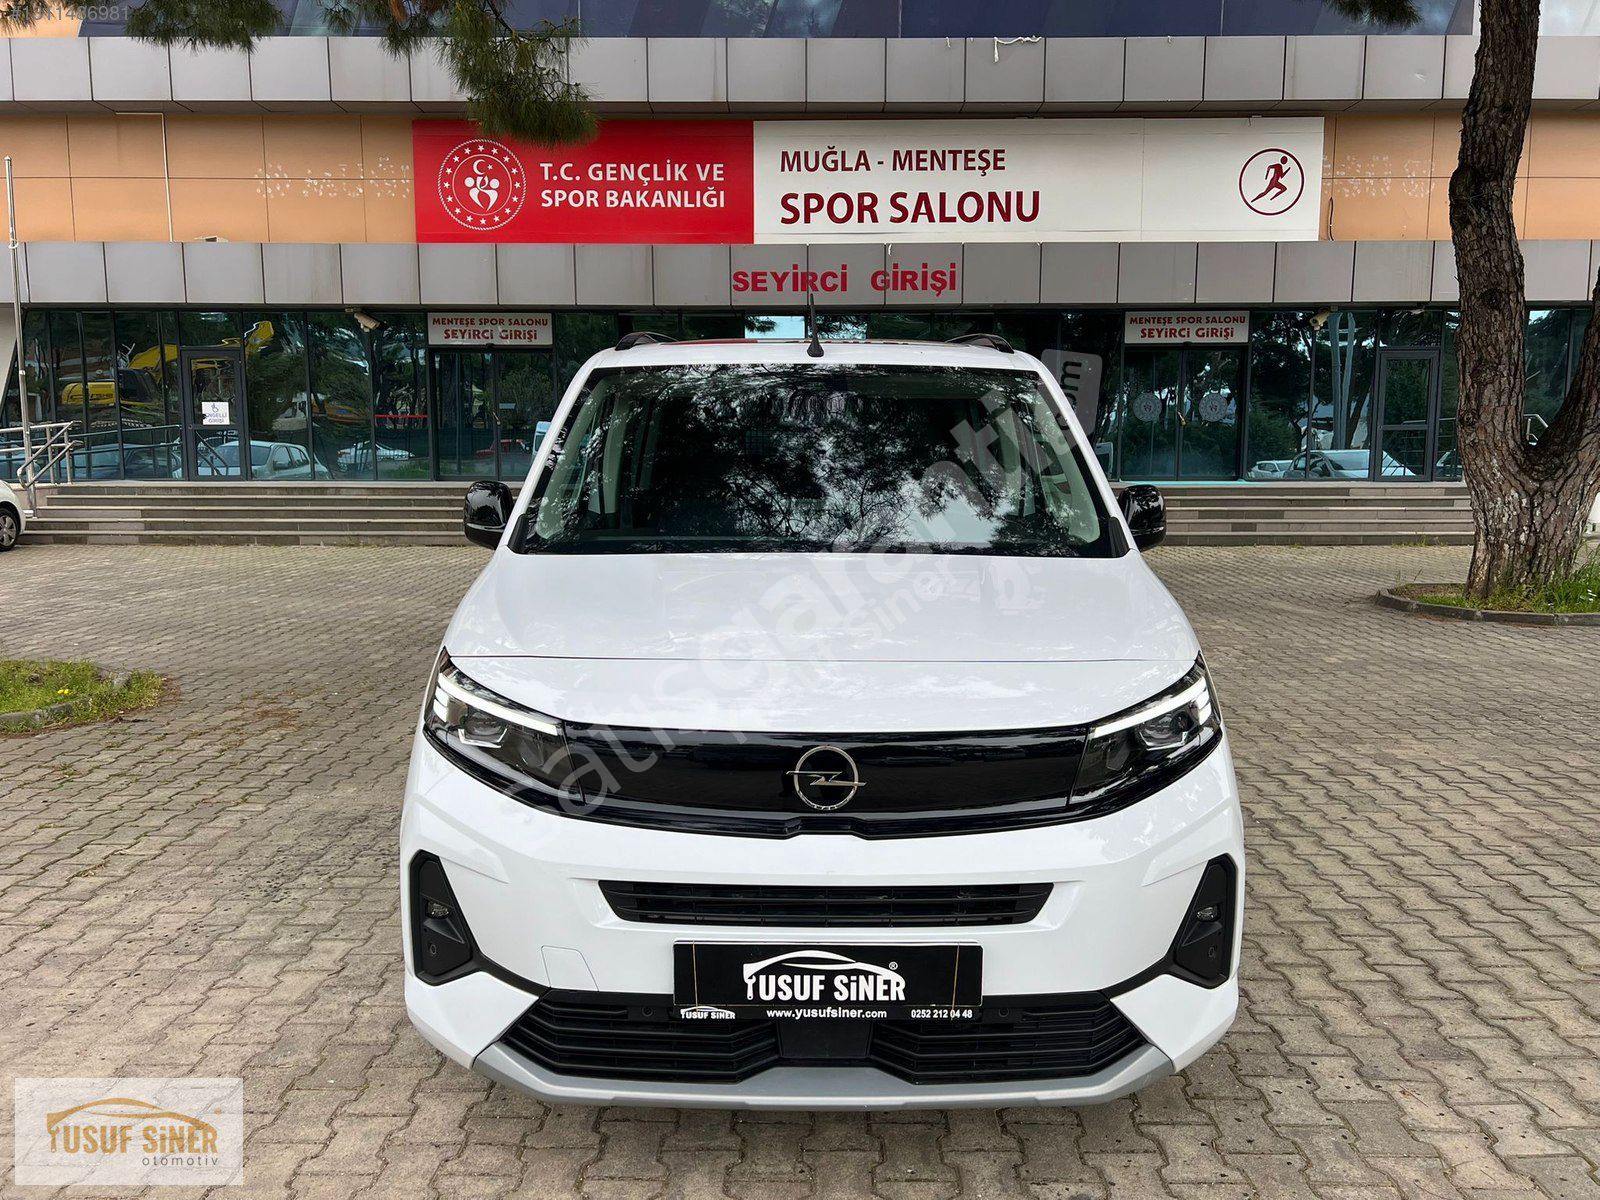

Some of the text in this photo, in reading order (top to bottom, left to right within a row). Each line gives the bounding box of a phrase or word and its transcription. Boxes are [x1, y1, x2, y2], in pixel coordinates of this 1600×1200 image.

[780, 144, 871, 173] MUĞLA
[891, 148, 1007, 177] MENTEŞE
[539, 158, 725, 187] T.C. GENÇLİK VE
[540, 185, 726, 208] SPOR BAKANLIĞI
[780, 190, 1041, 225] SPOR SALONU
[732, 262, 957, 297] SEYİRCİ GİRİŞİ
[432, 317, 549, 328] MENTEŞE SPOR SALONU
[1129, 316, 1246, 327] MENTEŞE SPOR SALONU
[744, 974, 826, 1001] YUSUF
[680, 1010, 710, 1020] YUSUF
[766, 1007, 887, 1019] www.yusufsiner.com
[911, 1010, 973, 1019] 0252 212 04 48
